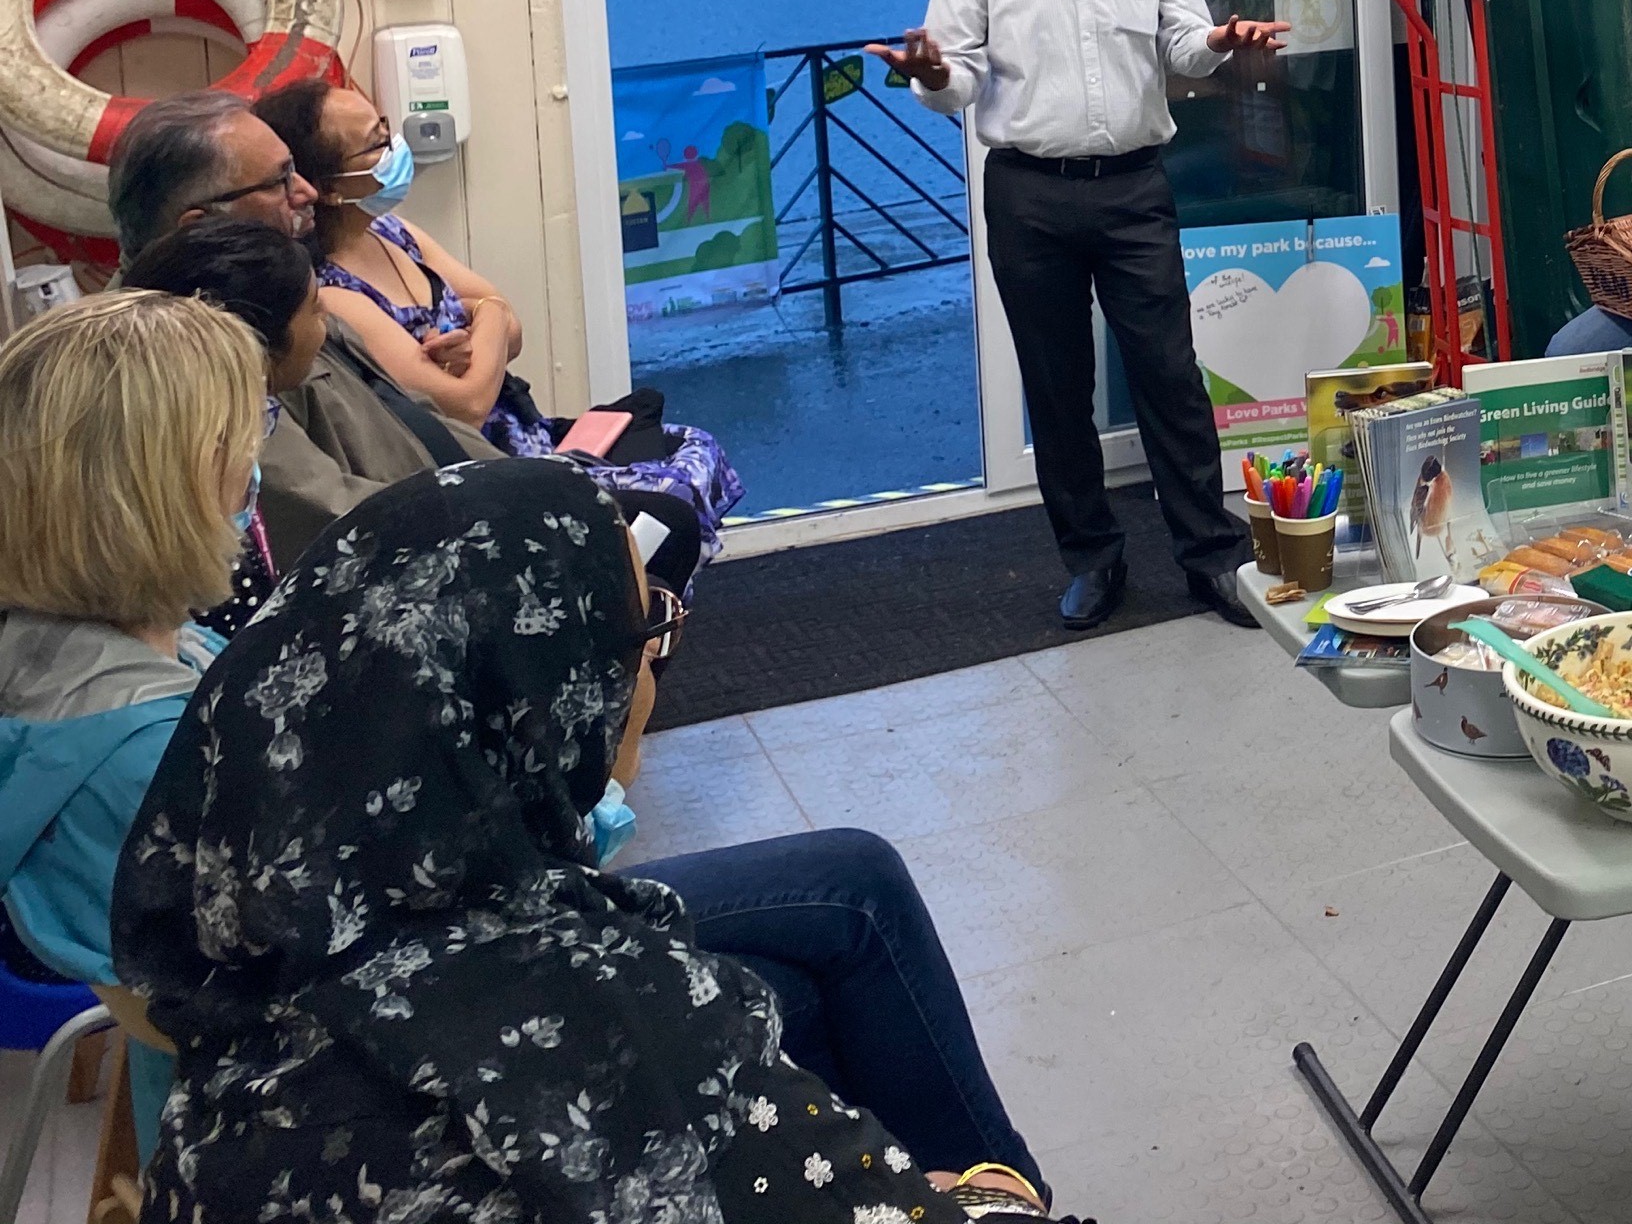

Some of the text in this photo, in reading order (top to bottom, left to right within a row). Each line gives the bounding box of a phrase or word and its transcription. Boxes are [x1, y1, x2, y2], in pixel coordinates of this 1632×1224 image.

[1220, 243, 1247, 259] my
[1252, 239, 1290, 257] park
[1294, 235, 1377, 251] bcause...
[1226, 407, 1259, 420] Love
[1261, 402, 1298, 416] Parks
[1523, 399, 1568, 417] Living
[1501, 474, 1516, 483] How
[1516, 472, 1524, 480] to
[1525, 470, 1538, 479] live
[1544, 466, 1570, 477] greener
[1570, 462, 1598, 473] lifestyle
[1521, 476, 1577, 490] and save money
